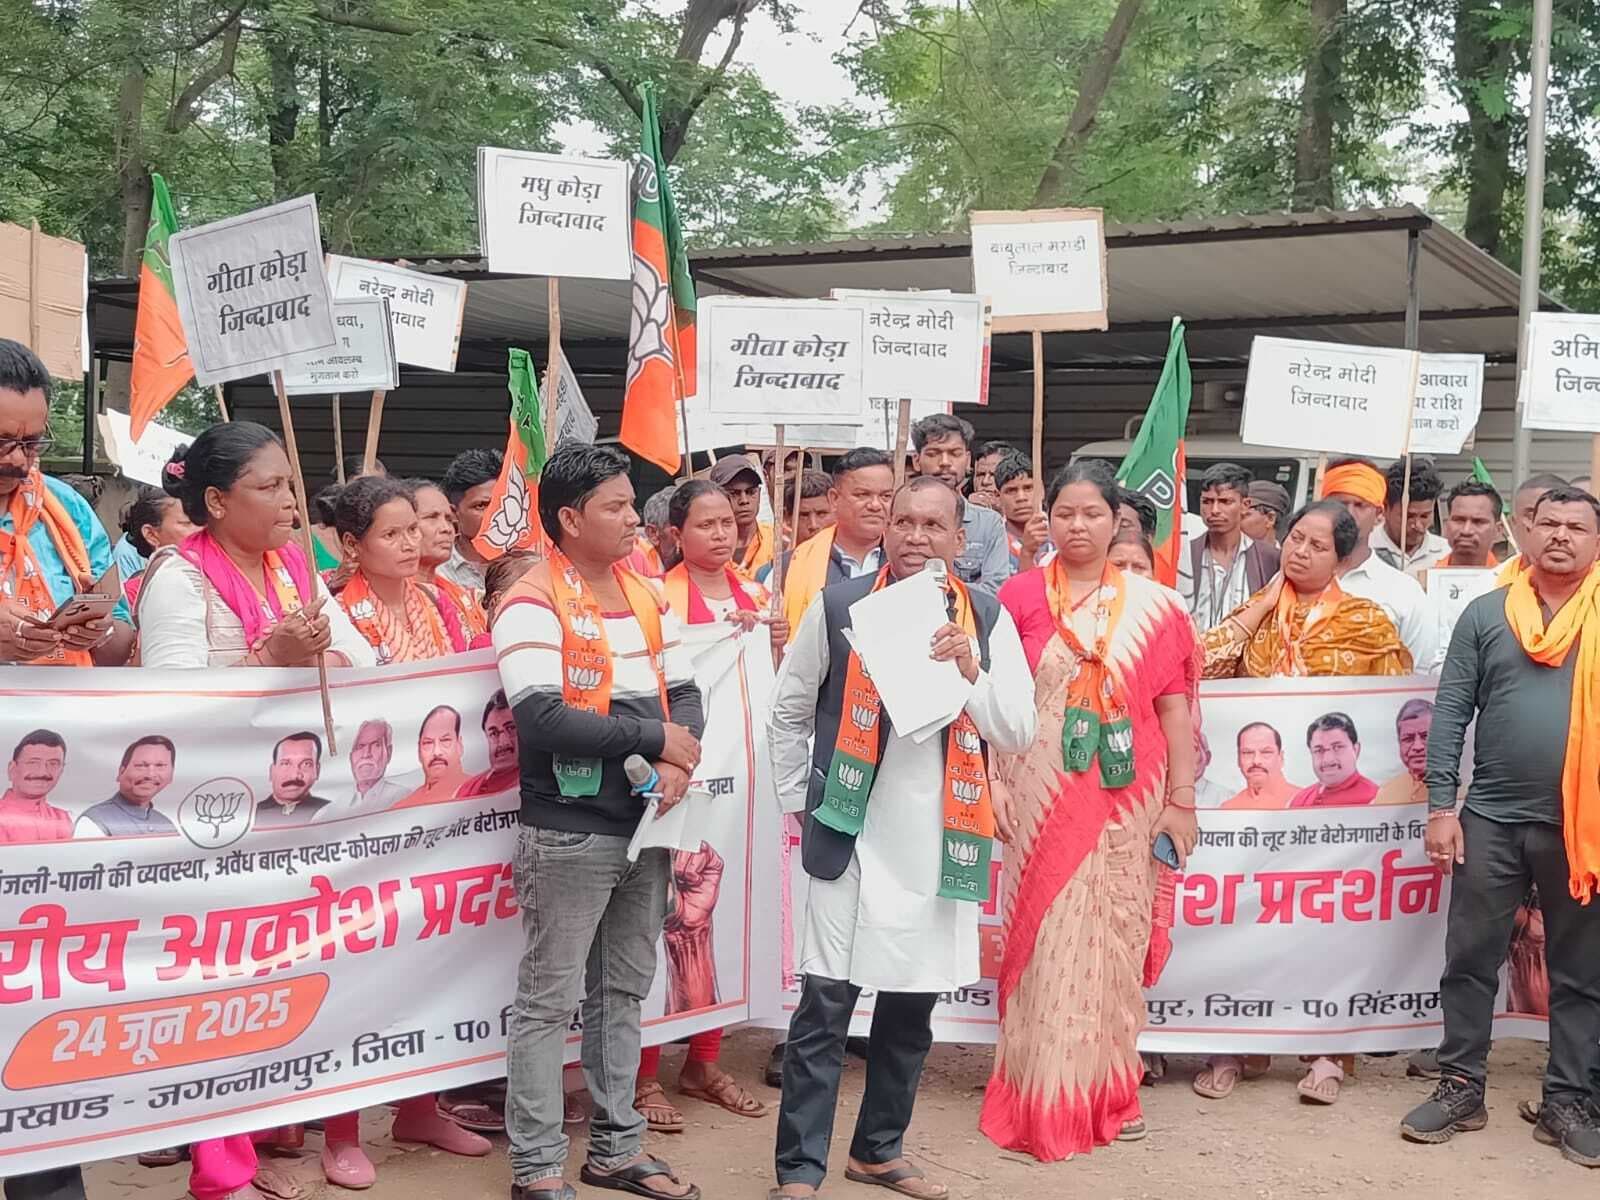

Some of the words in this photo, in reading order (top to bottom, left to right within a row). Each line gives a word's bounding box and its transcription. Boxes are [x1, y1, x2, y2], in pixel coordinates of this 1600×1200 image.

[520, 176, 552, 201] मधु
[557, 175, 603, 204] कोड़ा
[207, 262, 256, 294] गीता
[259, 249, 308, 282] कोड़ा
[401, 284, 434, 306] मोदी
[219, 294, 312, 335] जिन्दाबाद
[869, 306, 911, 330] नरेन्द्र
[916, 308, 955, 331] मोदी
[730, 332, 789, 357] गीता
[792, 333, 850, 363] कोड़ा
[733, 364, 846, 391] जिन्दाबाद
[1288, 357, 1332, 381] नरेन्द्र
[1338, 361, 1376, 385] मोदी
[1238, 827, 1258, 848] की
[1262, 829, 1287, 852] लूट
[1290, 825, 1317, 846] और
[1392, 821, 1405, 840] के
[109, 860, 135, 890] की
[138, 855, 210, 886] व्यवस्था,
[215, 850, 255, 876] अवैध
[258, 833, 402, 876] बालू-पत्थर-कोयला
[404, 825, 424, 849] की
[1254, 850, 1443, 926] प्रदर्शन
[156, 875, 400, 981] आक्रोश
[1204, 993, 1273, 1018] जिला
[52, 1016, 107, 1063] 24
[117, 1005, 191, 1066] जून
[197, 988, 291, 1043] 2025
[147, 1048, 342, 1110] जगन्नाथपुर,
[351, 1027, 425, 1067] जिला
